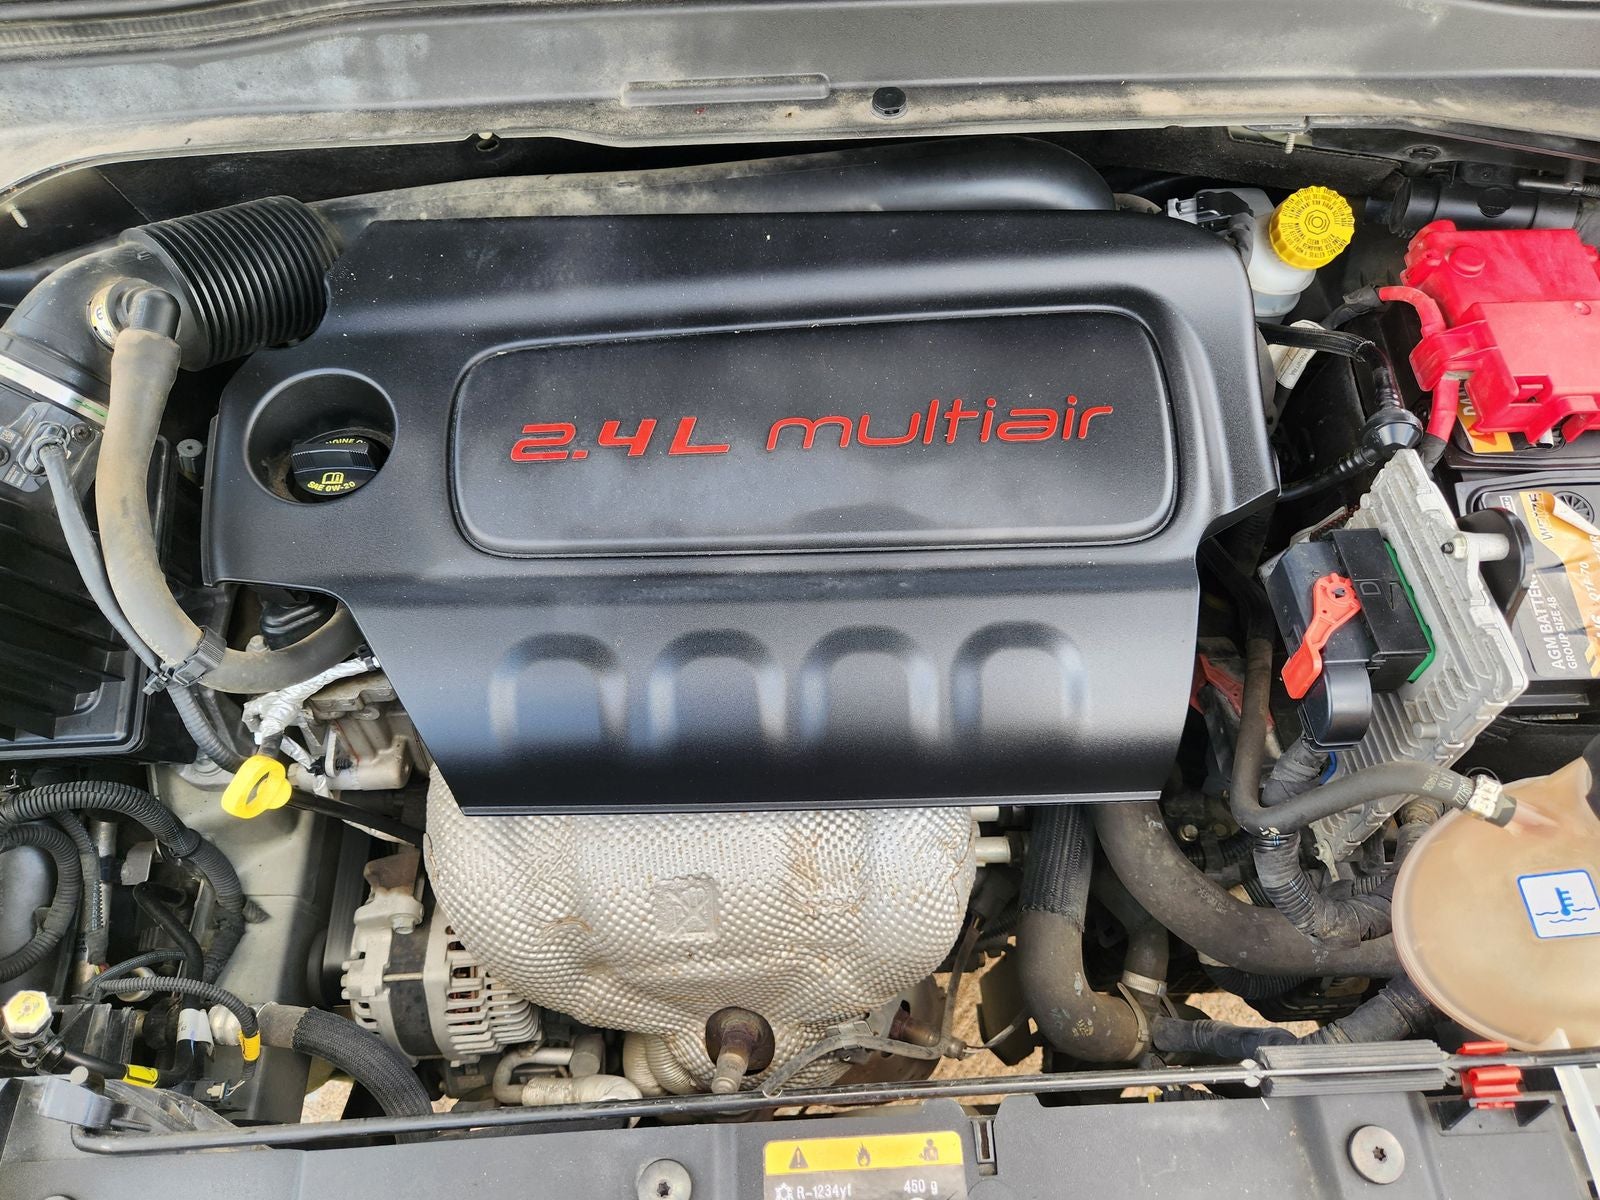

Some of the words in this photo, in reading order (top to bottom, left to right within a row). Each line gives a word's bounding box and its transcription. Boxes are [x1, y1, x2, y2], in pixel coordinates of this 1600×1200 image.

[765, 395, 1114, 453] multiair
[307, 481, 325, 492] SAE
[1551, 610, 1567, 632] SIZE
[1543, 637, 1567, 670] AGM
[1558, 632, 1578, 670] GROUP
